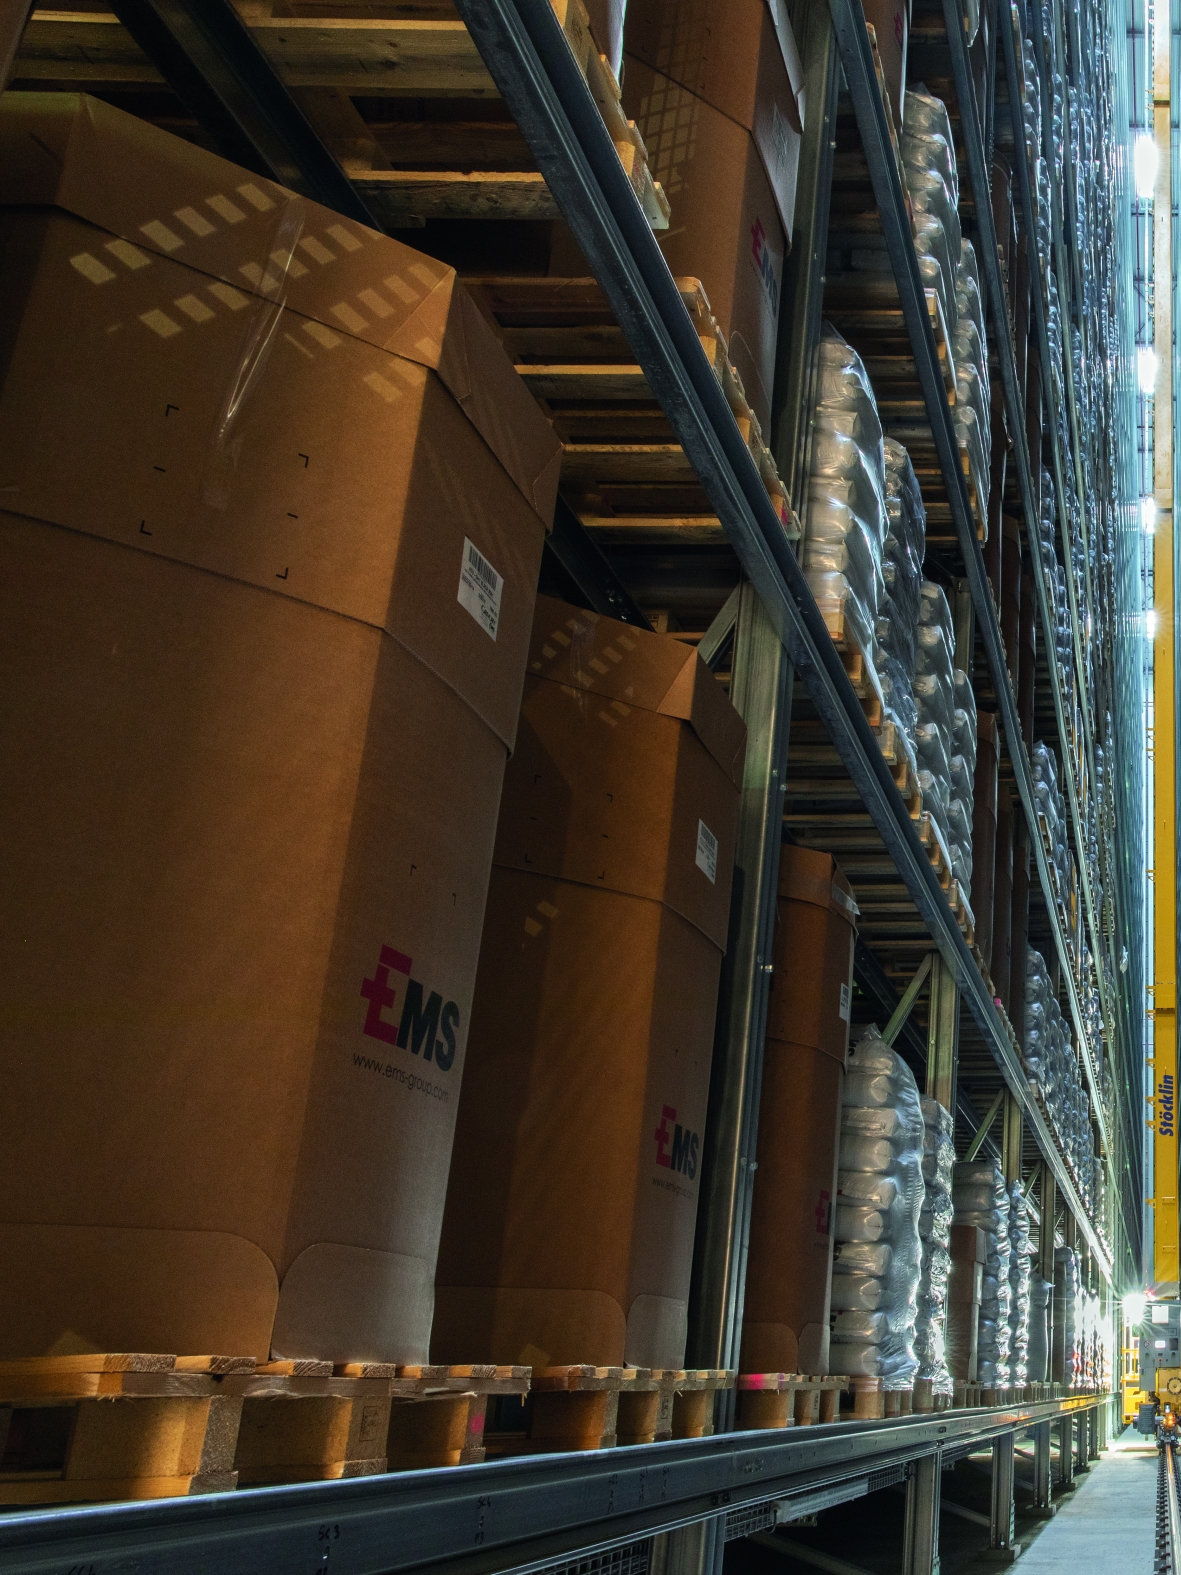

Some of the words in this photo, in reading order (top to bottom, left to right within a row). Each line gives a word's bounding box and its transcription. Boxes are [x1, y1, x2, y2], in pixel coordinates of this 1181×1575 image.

[360, 943, 461, 1073] EMS
[352, 1052, 450, 1104] www.ems-group.com
[1158, 1074, 1174, 1137] Stöcklin
[654, 1104, 700, 1180] EMS
